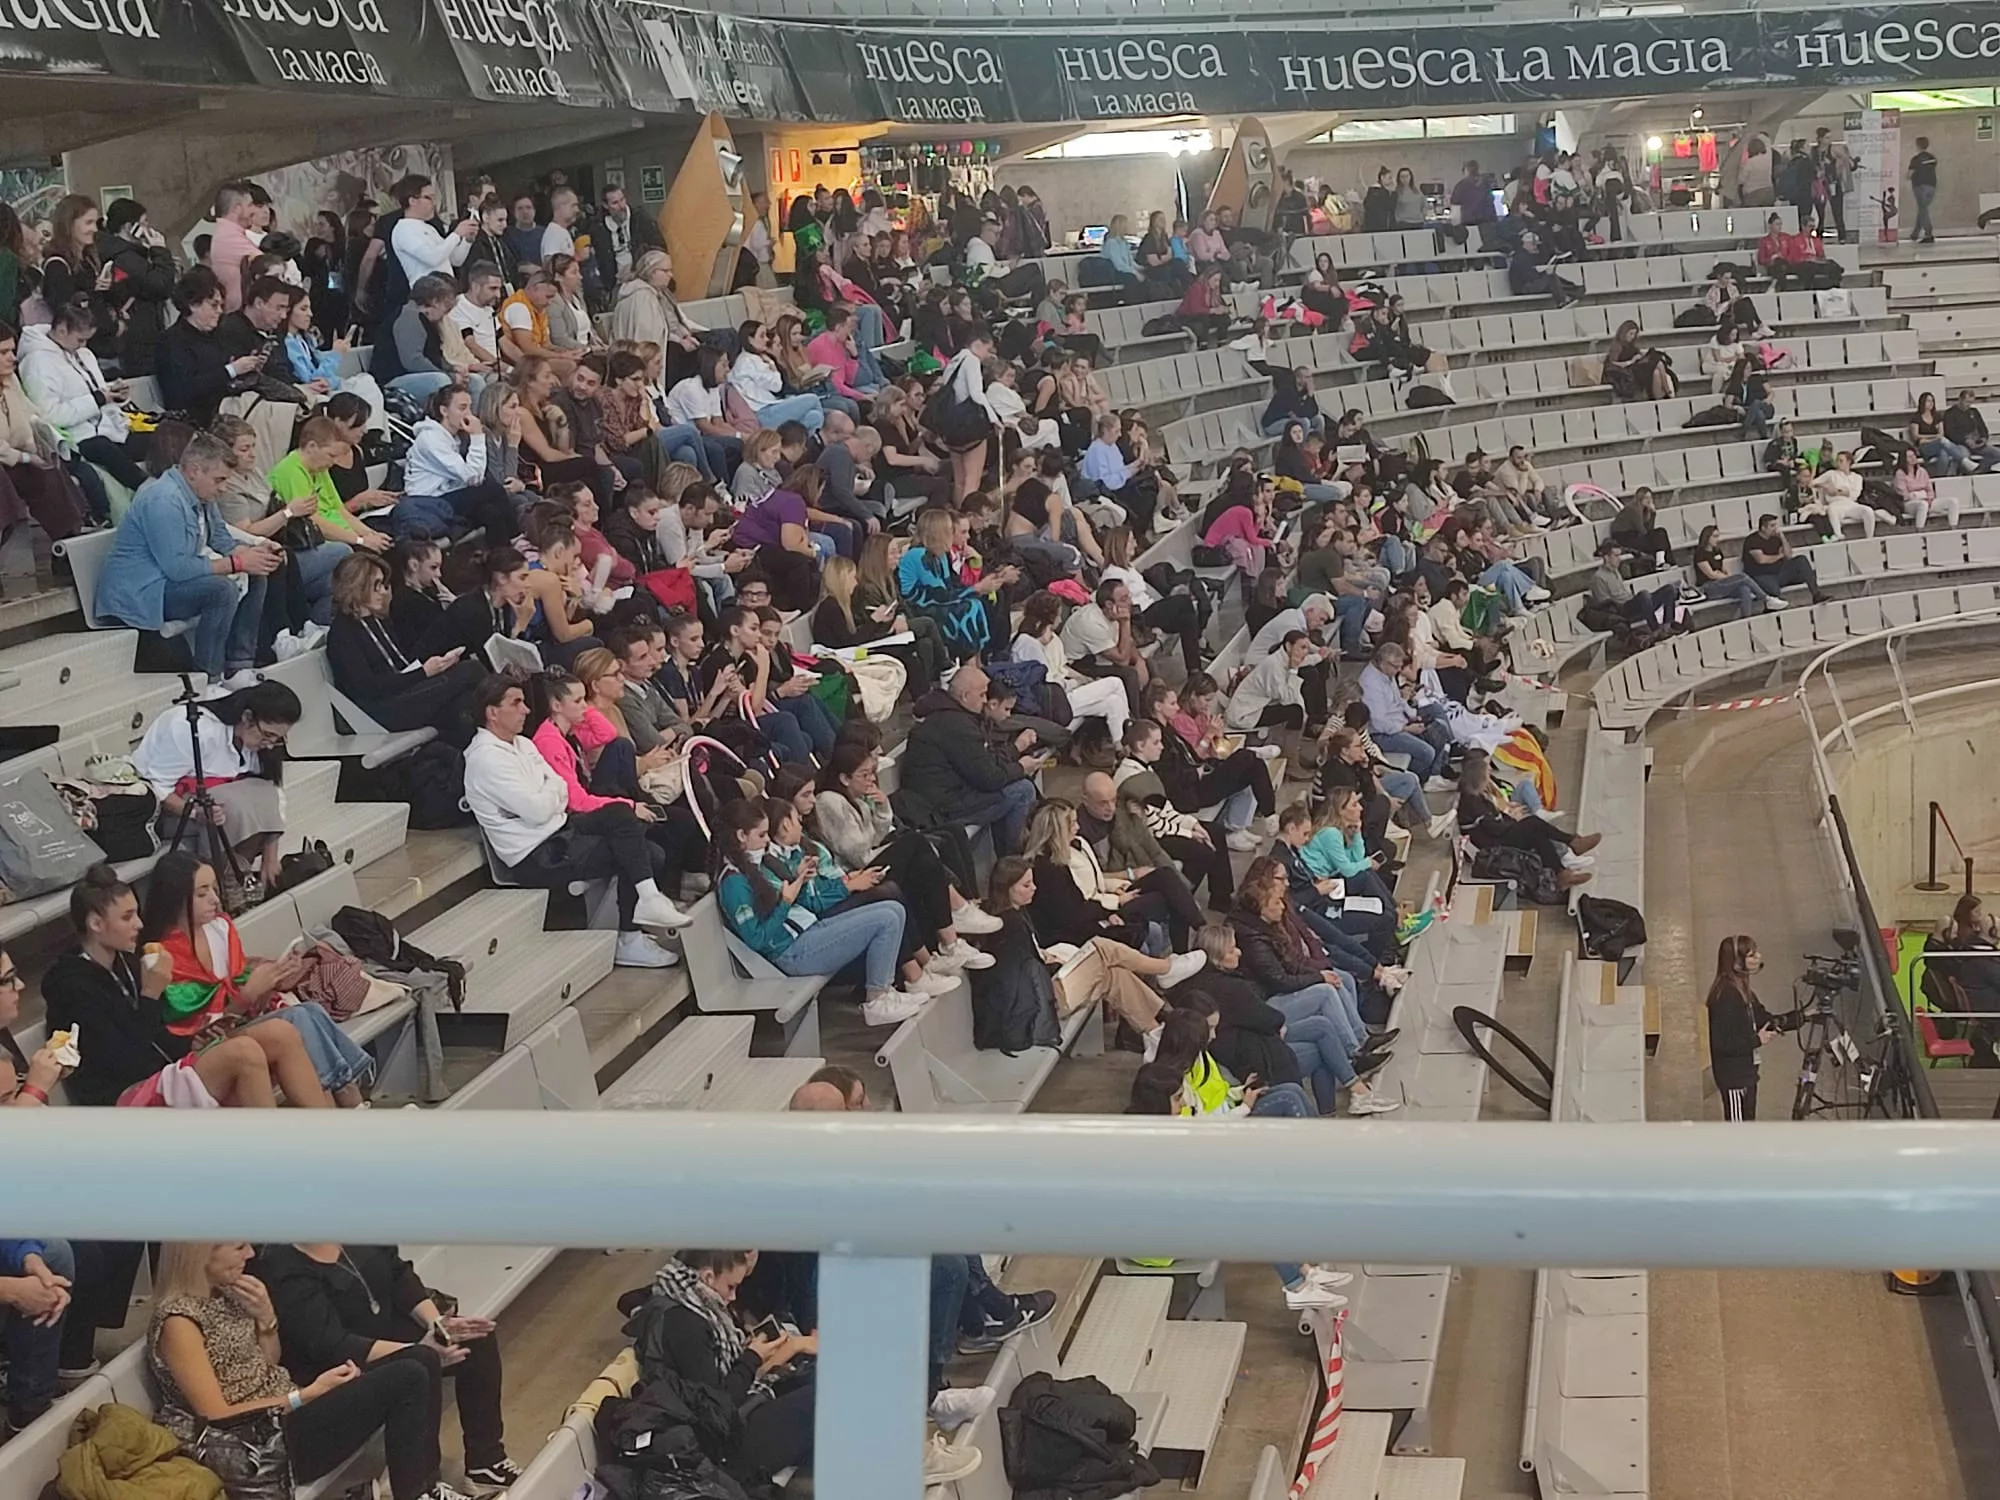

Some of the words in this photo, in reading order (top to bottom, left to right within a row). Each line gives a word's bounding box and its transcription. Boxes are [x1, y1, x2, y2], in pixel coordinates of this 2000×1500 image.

[856, 40, 1003, 85] Huesca
[1058, 39, 1228, 81] Huesca
[1794, 18, 2000, 68] Huesca
[266, 47, 311, 82] La
[1278, 46, 1483, 92] Huesca
[1491, 46, 1555, 83] La
[896, 96, 923, 119] La
[1093, 94, 1123, 115] La
